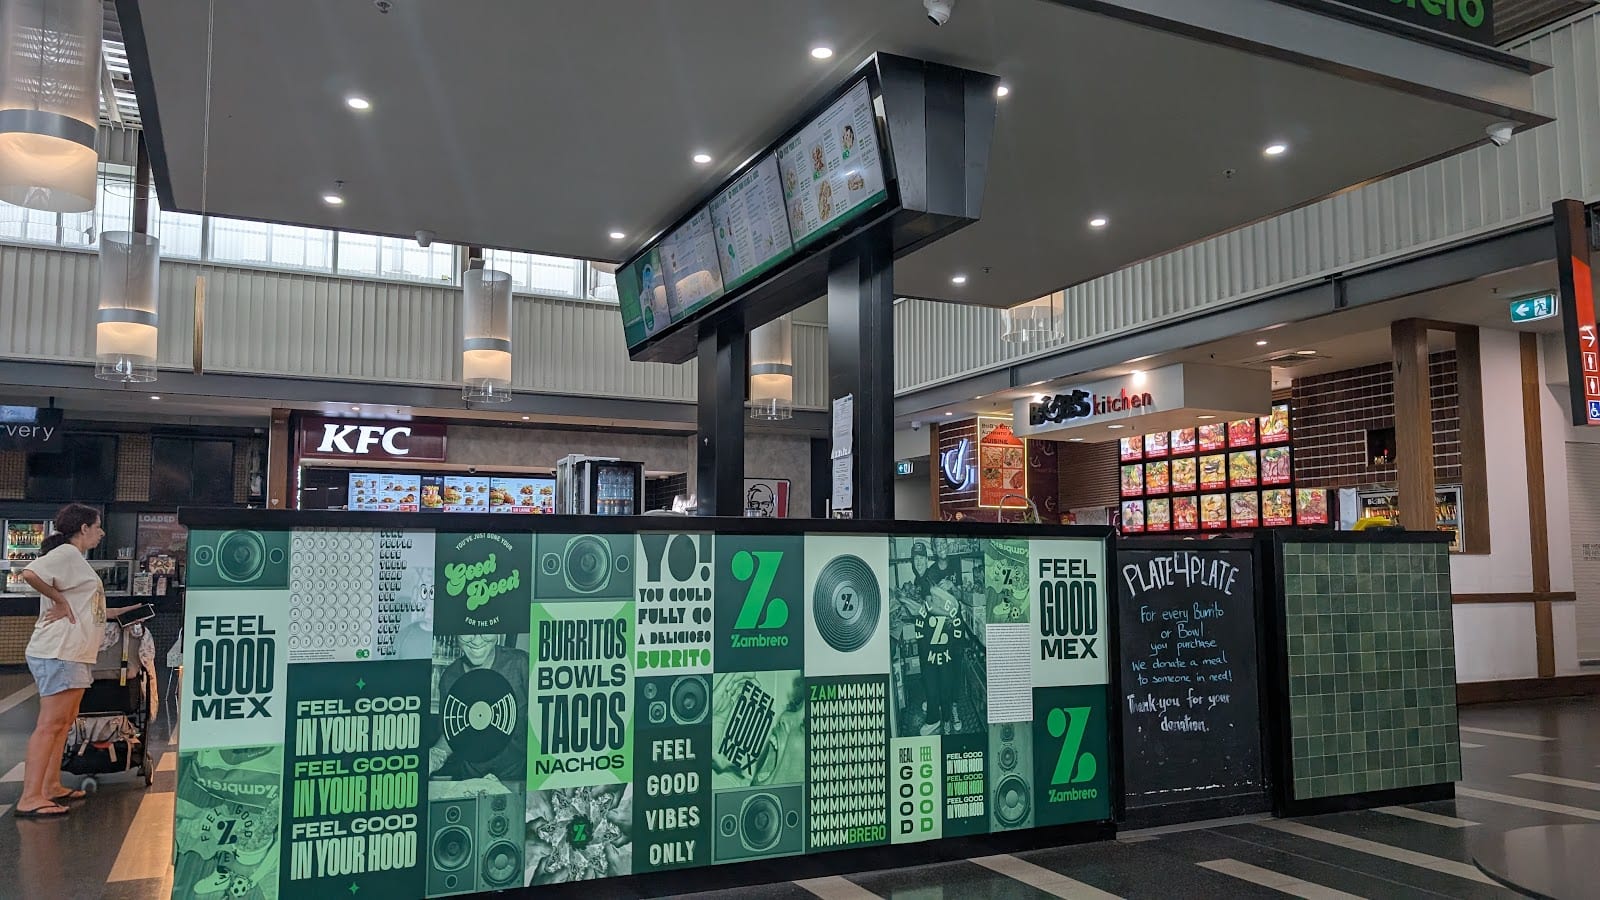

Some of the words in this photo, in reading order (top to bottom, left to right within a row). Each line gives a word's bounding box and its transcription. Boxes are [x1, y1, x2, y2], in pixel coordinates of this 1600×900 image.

[1092, 387, 1152, 416] kitchen
[317, 423, 412, 455] KFC
[139, 514, 176, 523] LOADED
[639, 534, 713, 582] YO!
[1039, 559, 1097, 578] FEEL
[444, 553, 497, 597] Good
[1122, 552, 1239, 597] PLATE4PLATE
[466, 569, 520, 611] Deed
[639, 588, 664, 602] YOU
[669, 587, 712, 602] COULD
[638, 607, 686, 624] FULLY
[692, 607, 712, 624] GO
[915, 601, 933, 640] FEEL
[944, 599, 962, 639] GOOD
[1040, 580, 1098, 637] GOOD
[1140, 605, 1156, 623] For
[1162, 609, 1188, 624] every
[1193, 601, 1224, 619] Burrito
[195, 615, 276, 636] FEEL
[465, 616, 476, 626] FOR
[489, 616, 500, 626] DAY
[1161, 630, 1172, 638] or
[1178, 622, 1203, 638] Bowl
[538, 618, 627, 662] BURRITOS
[638, 633, 646, 645] A
[650, 630, 712, 645] DELICIOSO
[731, 634, 789, 648] Zambrero
[1041, 638, 1098, 660] MEX
[1149, 642, 1168, 657] you
[1177, 638, 1217, 656] purchase
[193, 637, 276, 697] GOOD
[637, 648, 711, 669] BURRITO
[927, 649, 952, 665] MEX
[1152, 657, 1186, 669] donate
[1203, 650, 1228, 665] meal
[537, 663, 627, 690] BOWLS
[1138, 673, 1149, 686] to
[1152, 673, 1191, 683] someone
[1196, 671, 1205, 681] in
[1209, 669, 1233, 682] need!
[191, 696, 273, 721] MEX
[297, 699, 351, 716] FEEL
[355, 696, 421, 713] GOOD
[742, 680, 774, 715] FEEL
[1187, 688, 1203, 708] for
[1207, 694, 1230, 711] your
[444, 694, 470, 740] FEEL
[491, 693, 517, 735] GOOD
[537, 691, 626, 755] TACOS
[725, 694, 775, 759] GOOD
[1161, 714, 1210, 732] donation.
[295, 717, 317, 756] IN
[320, 715, 369, 755] YOUR
[371, 712, 420, 751] HOOD
[652, 738, 696, 762] FEEL
[718, 738, 757, 776] MEX
[899, 748, 914, 763] REAL
[920, 746, 932, 762] FEEL
[294, 759, 349, 778] FEEL
[353, 755, 419, 773] GOOD
[535, 755, 625, 775] NACHOS
[646, 772, 700, 796] GOOD
[947, 775, 962, 783] FEEL
[963, 773, 983, 781] GOOD
[293, 779, 315, 818] IN
[318, 775, 367, 816] YOUR
[369, 771, 419, 812] HOOD
[900, 766, 914, 834] GOOD
[920, 764, 934, 832] GOOD
[963, 795, 983, 803] GOOD
[1049, 788, 1097, 802] Zambrero
[201, 808, 222, 842] FEEL
[292, 821, 347, 839] FEEL
[351, 814, 418, 834] GOOD
[645, 805, 701, 831] VIBES
[290, 841, 313, 880] IN
[316, 835, 366, 877] YOUR
[368, 830, 417, 872] HOOD
[649, 840, 697, 865] ONLY
